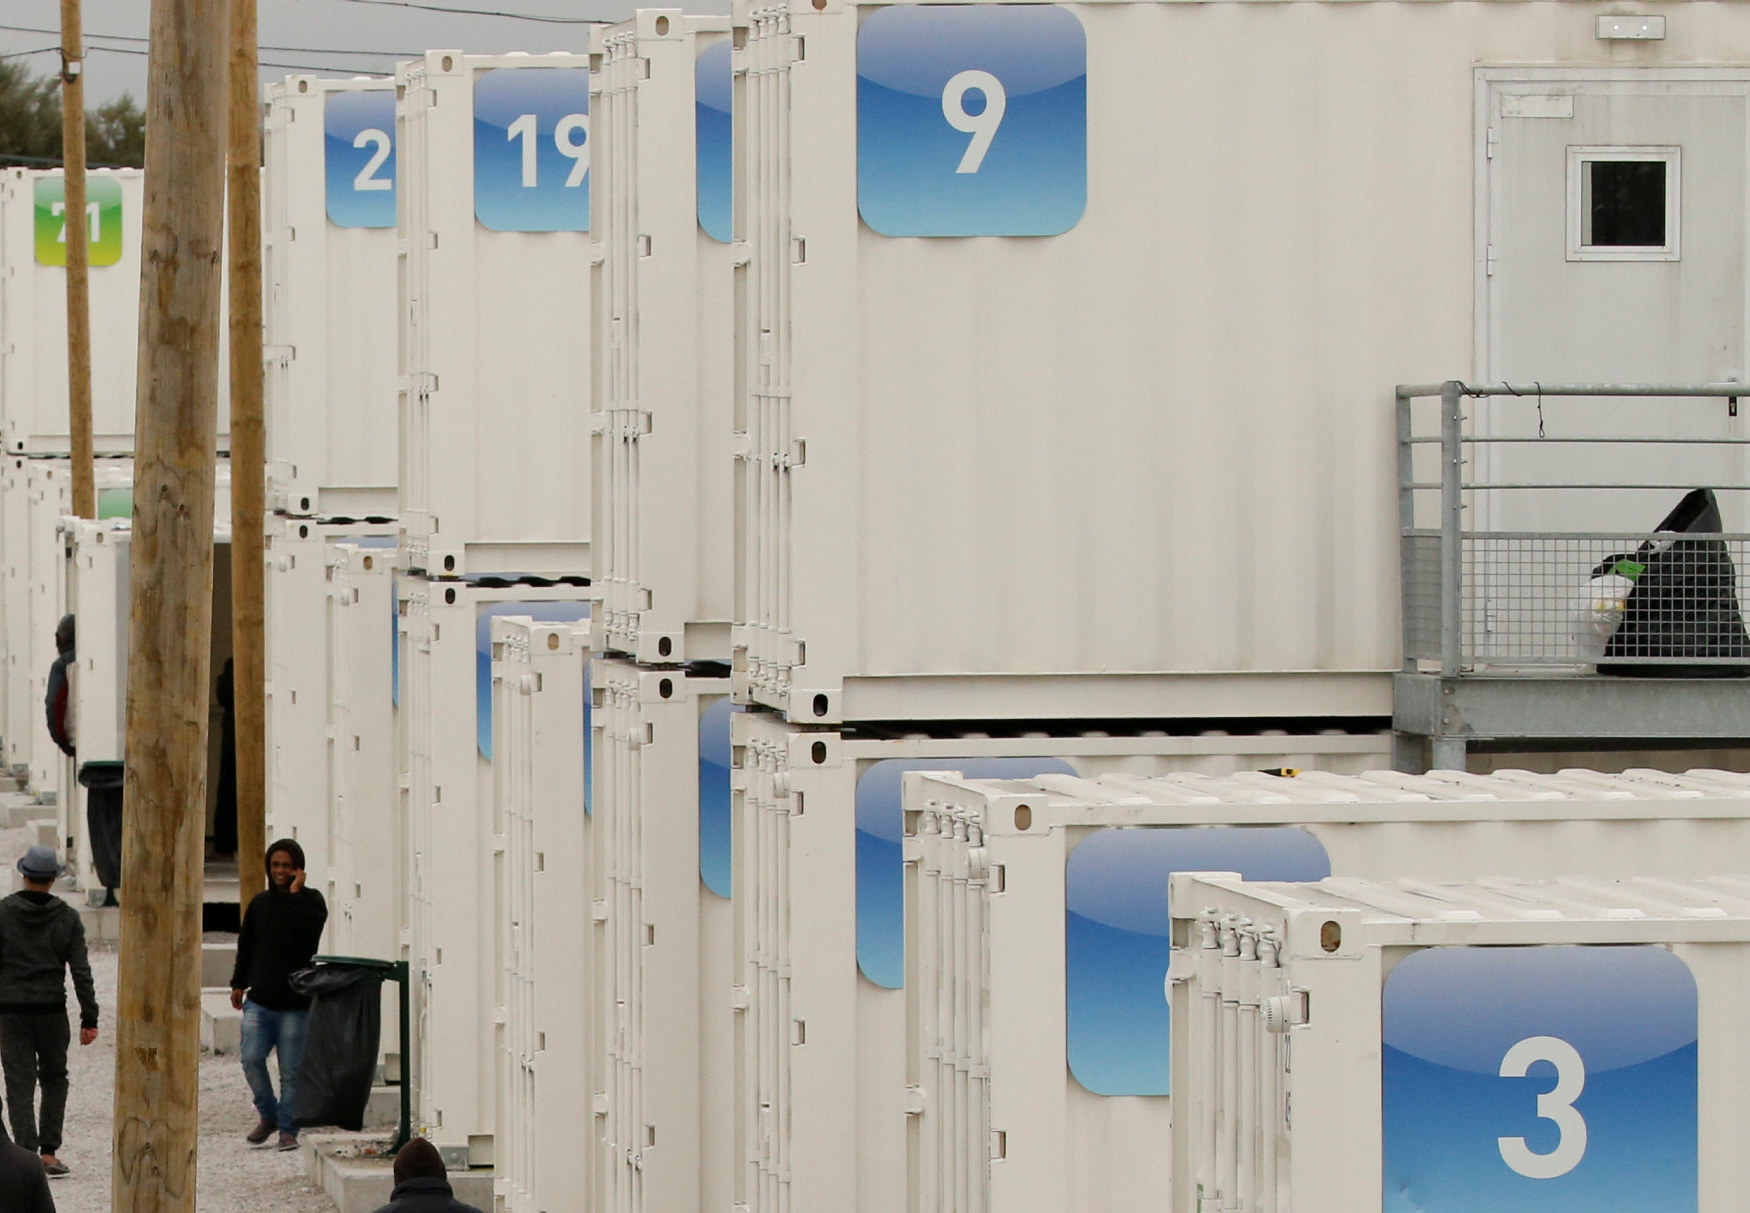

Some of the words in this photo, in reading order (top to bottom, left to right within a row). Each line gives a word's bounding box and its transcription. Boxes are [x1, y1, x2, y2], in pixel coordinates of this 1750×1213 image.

[353, 128, 392, 191] 2
[507, 113, 590, 188] 19
[941, 69, 1007, 174] 9
[1497, 1035, 1588, 1179] 3
